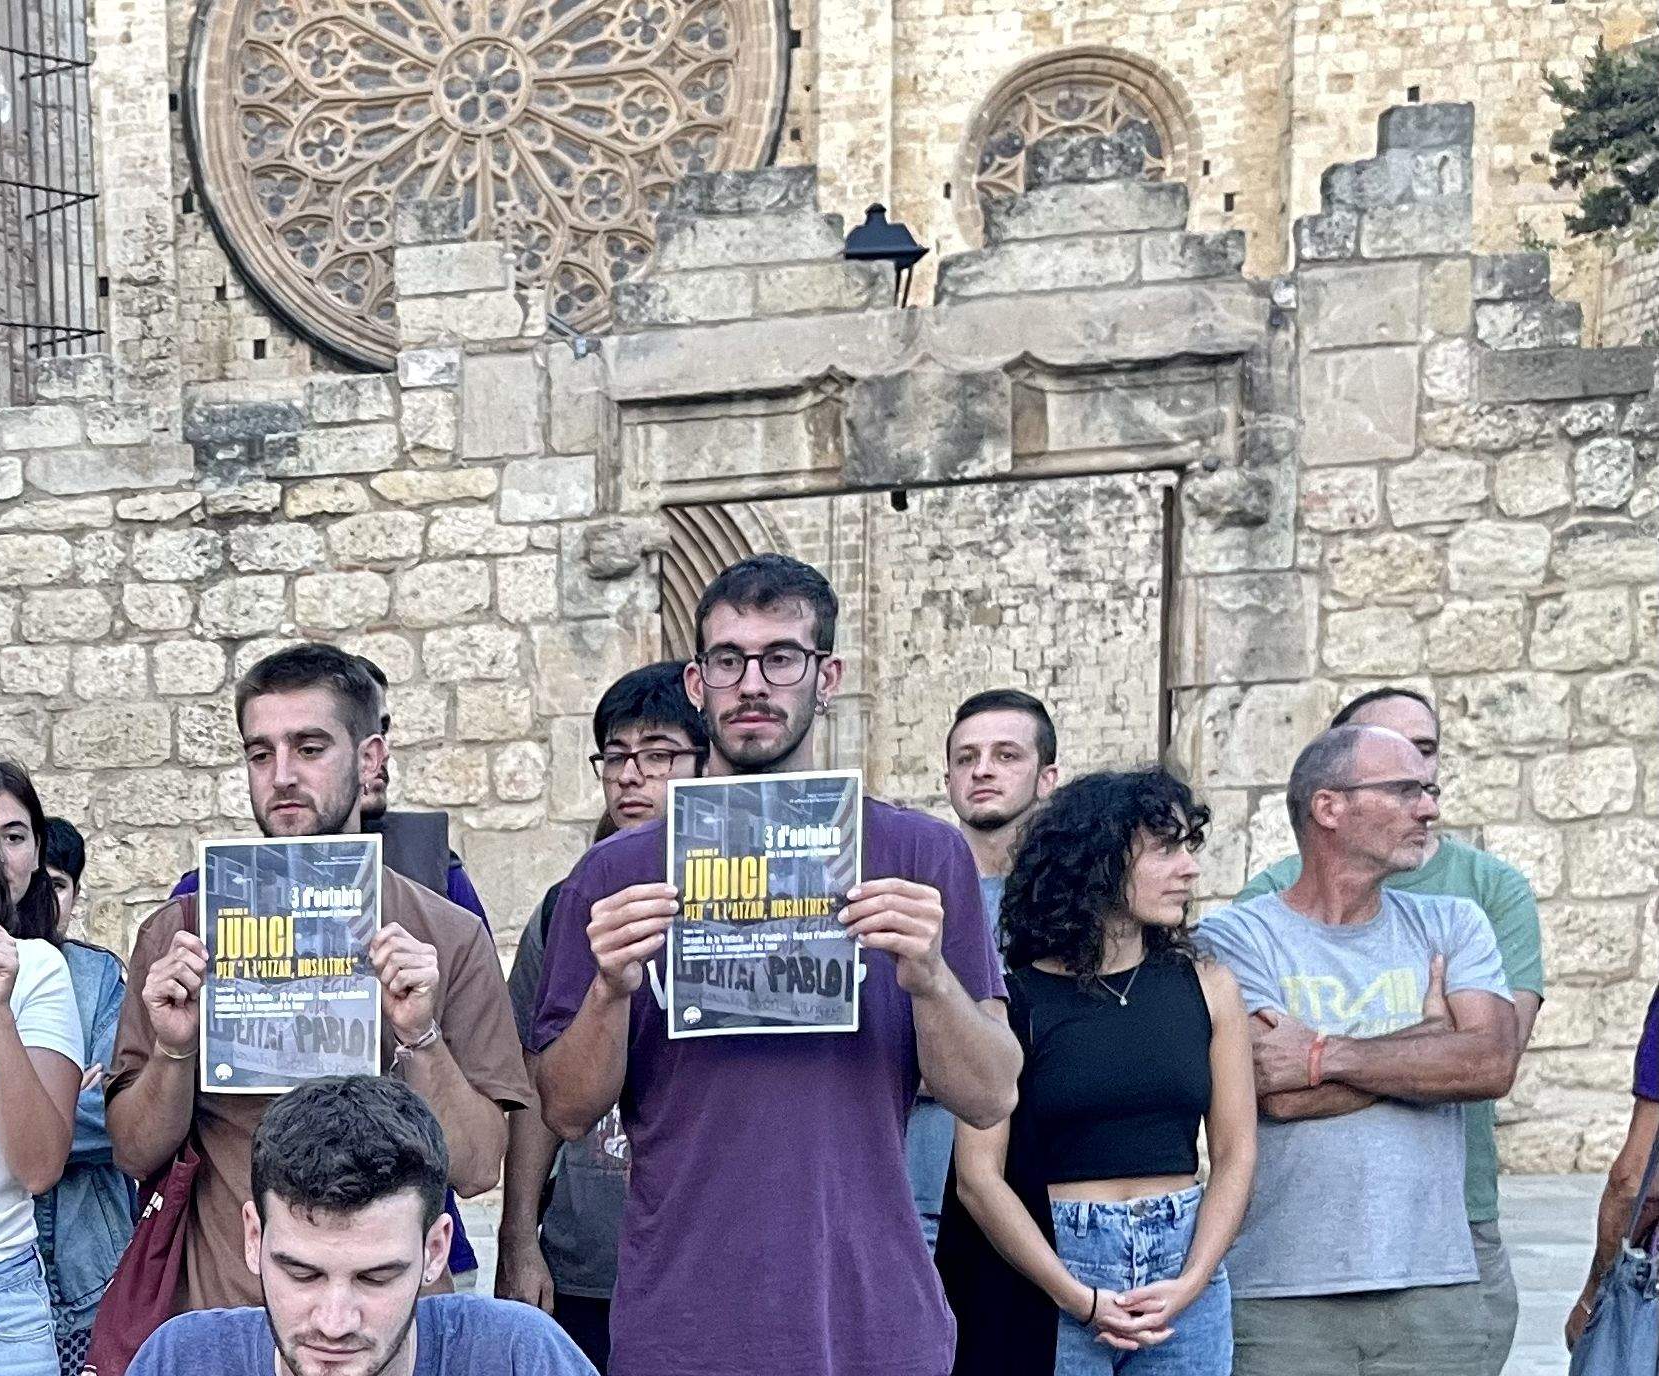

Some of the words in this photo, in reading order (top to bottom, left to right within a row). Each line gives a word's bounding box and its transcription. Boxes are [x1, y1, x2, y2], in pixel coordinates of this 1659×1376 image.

[764, 825, 773, 848] 3
[777, 823, 841, 848] d'octubre
[684, 856, 768, 901] JUDICI
[291, 886, 300, 908] 3
[302, 885, 362, 908] d'octubre
[684, 903, 704, 922] PER
[216, 915, 293, 960] JUDICI
[216, 961, 234, 979] PER
[763, 956, 842, 997] PABLO
[292, 1014, 365, 1057] PABLO
